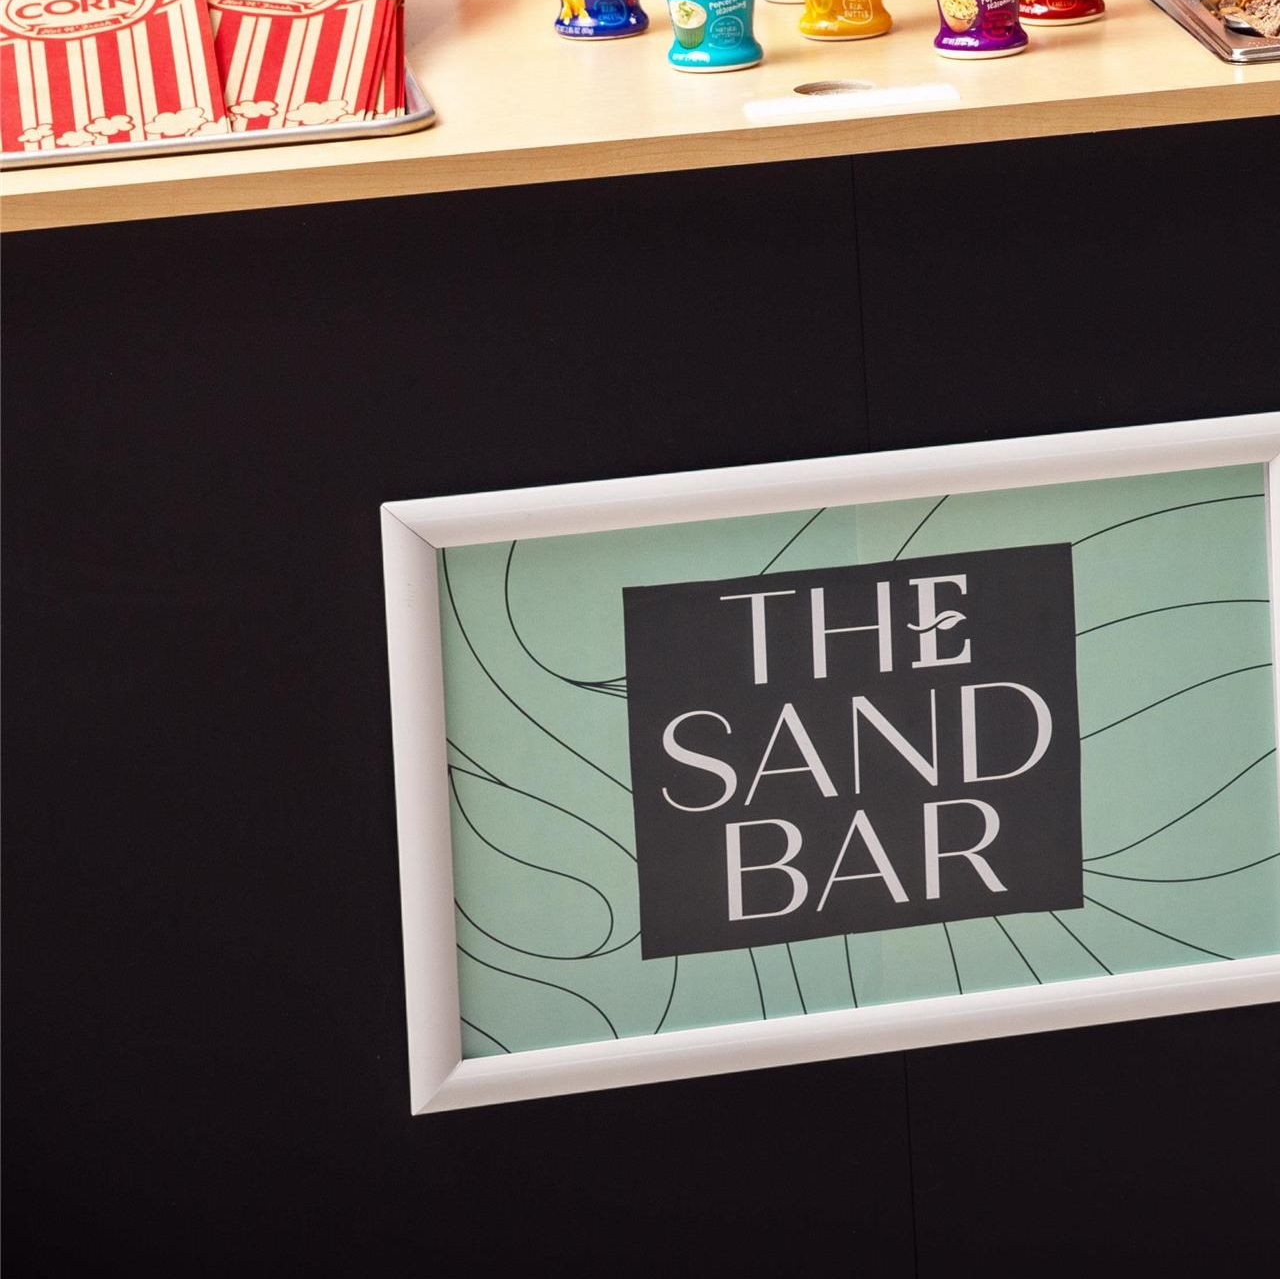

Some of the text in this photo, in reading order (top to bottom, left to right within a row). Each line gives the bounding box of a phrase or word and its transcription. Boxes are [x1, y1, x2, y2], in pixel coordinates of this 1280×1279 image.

[720, 573, 972, 685] THE
[660, 681, 1054, 813] SAND
[725, 798, 1009, 922] BAR
